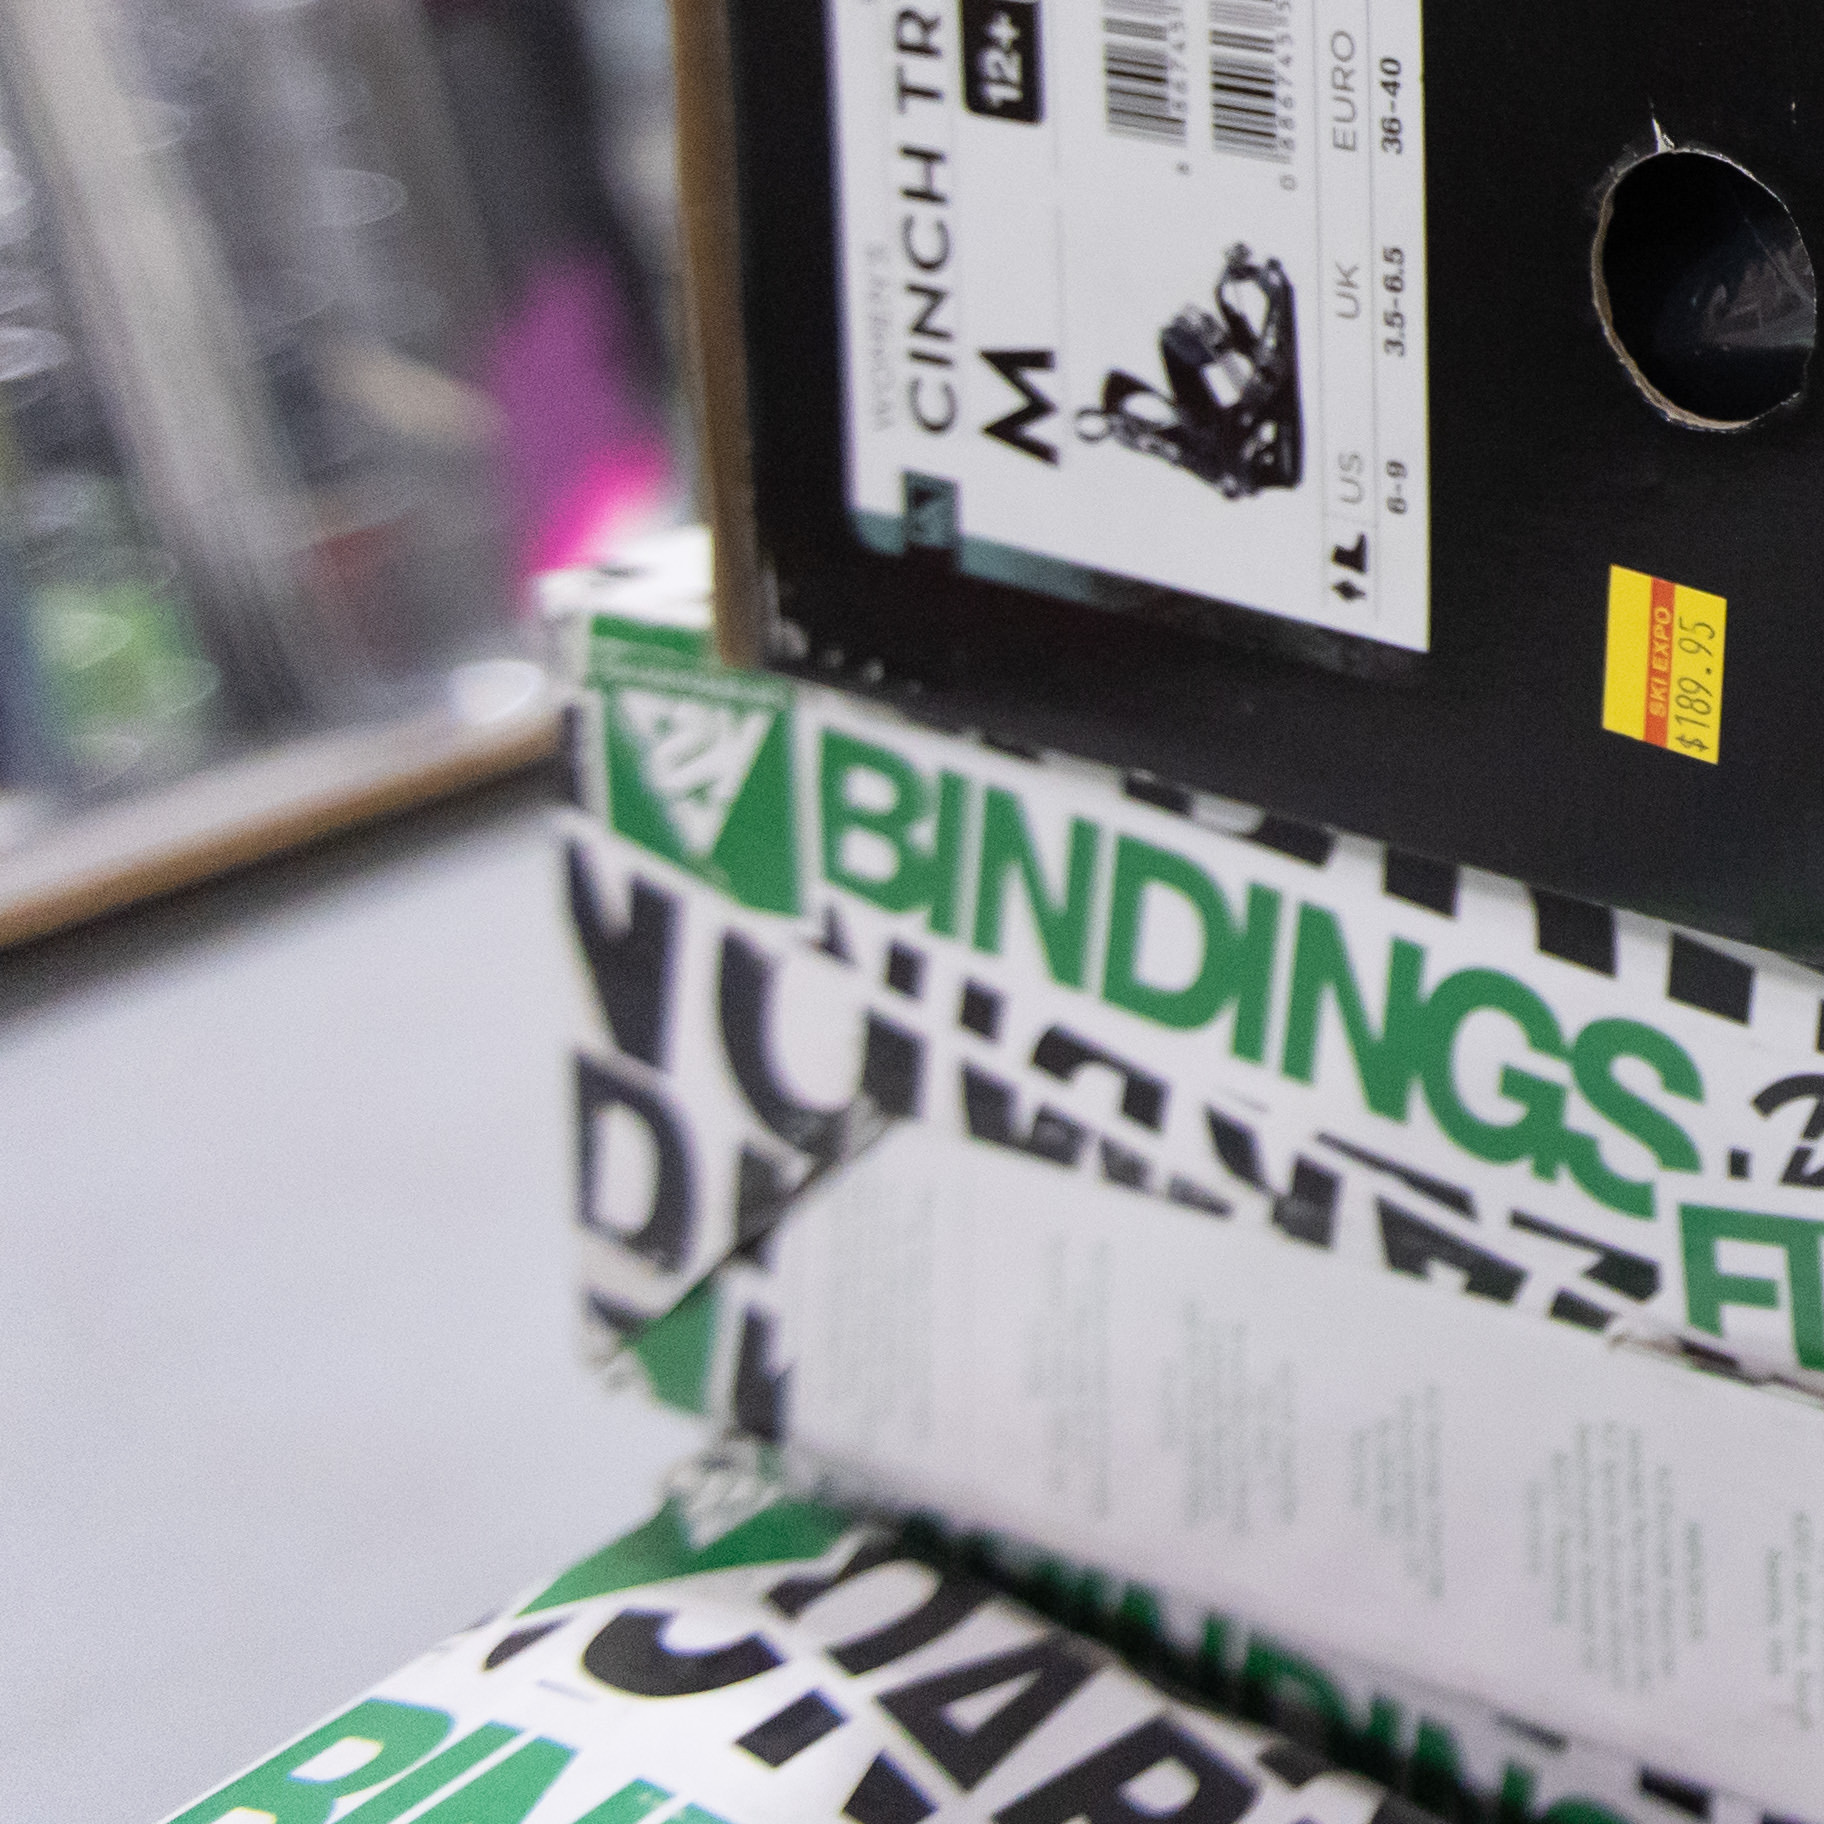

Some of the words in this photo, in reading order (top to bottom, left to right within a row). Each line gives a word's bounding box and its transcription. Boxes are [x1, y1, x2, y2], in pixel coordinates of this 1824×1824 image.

[981, 6, 1023, 108] 12+
[1331, 28, 1361, 153] EURO
[1379, 56, 1406, 157] 36-40
[900, 141, 960, 436] CINCH
[1335, 262, 1363, 322] UK
[1382, 245, 1409, 358] 3.5-6.5
[978, 346, 1060, 468] M
[1337, 449, 1366, 507] US
[1385, 458, 1410, 517] 6-9
[1651, 605, 1674, 673] EXPO
[1672, 614, 1716, 753] $189.95
[1648, 676, 1668, 719] SKI
[818, 729, 1705, 1221] BINDINGS
